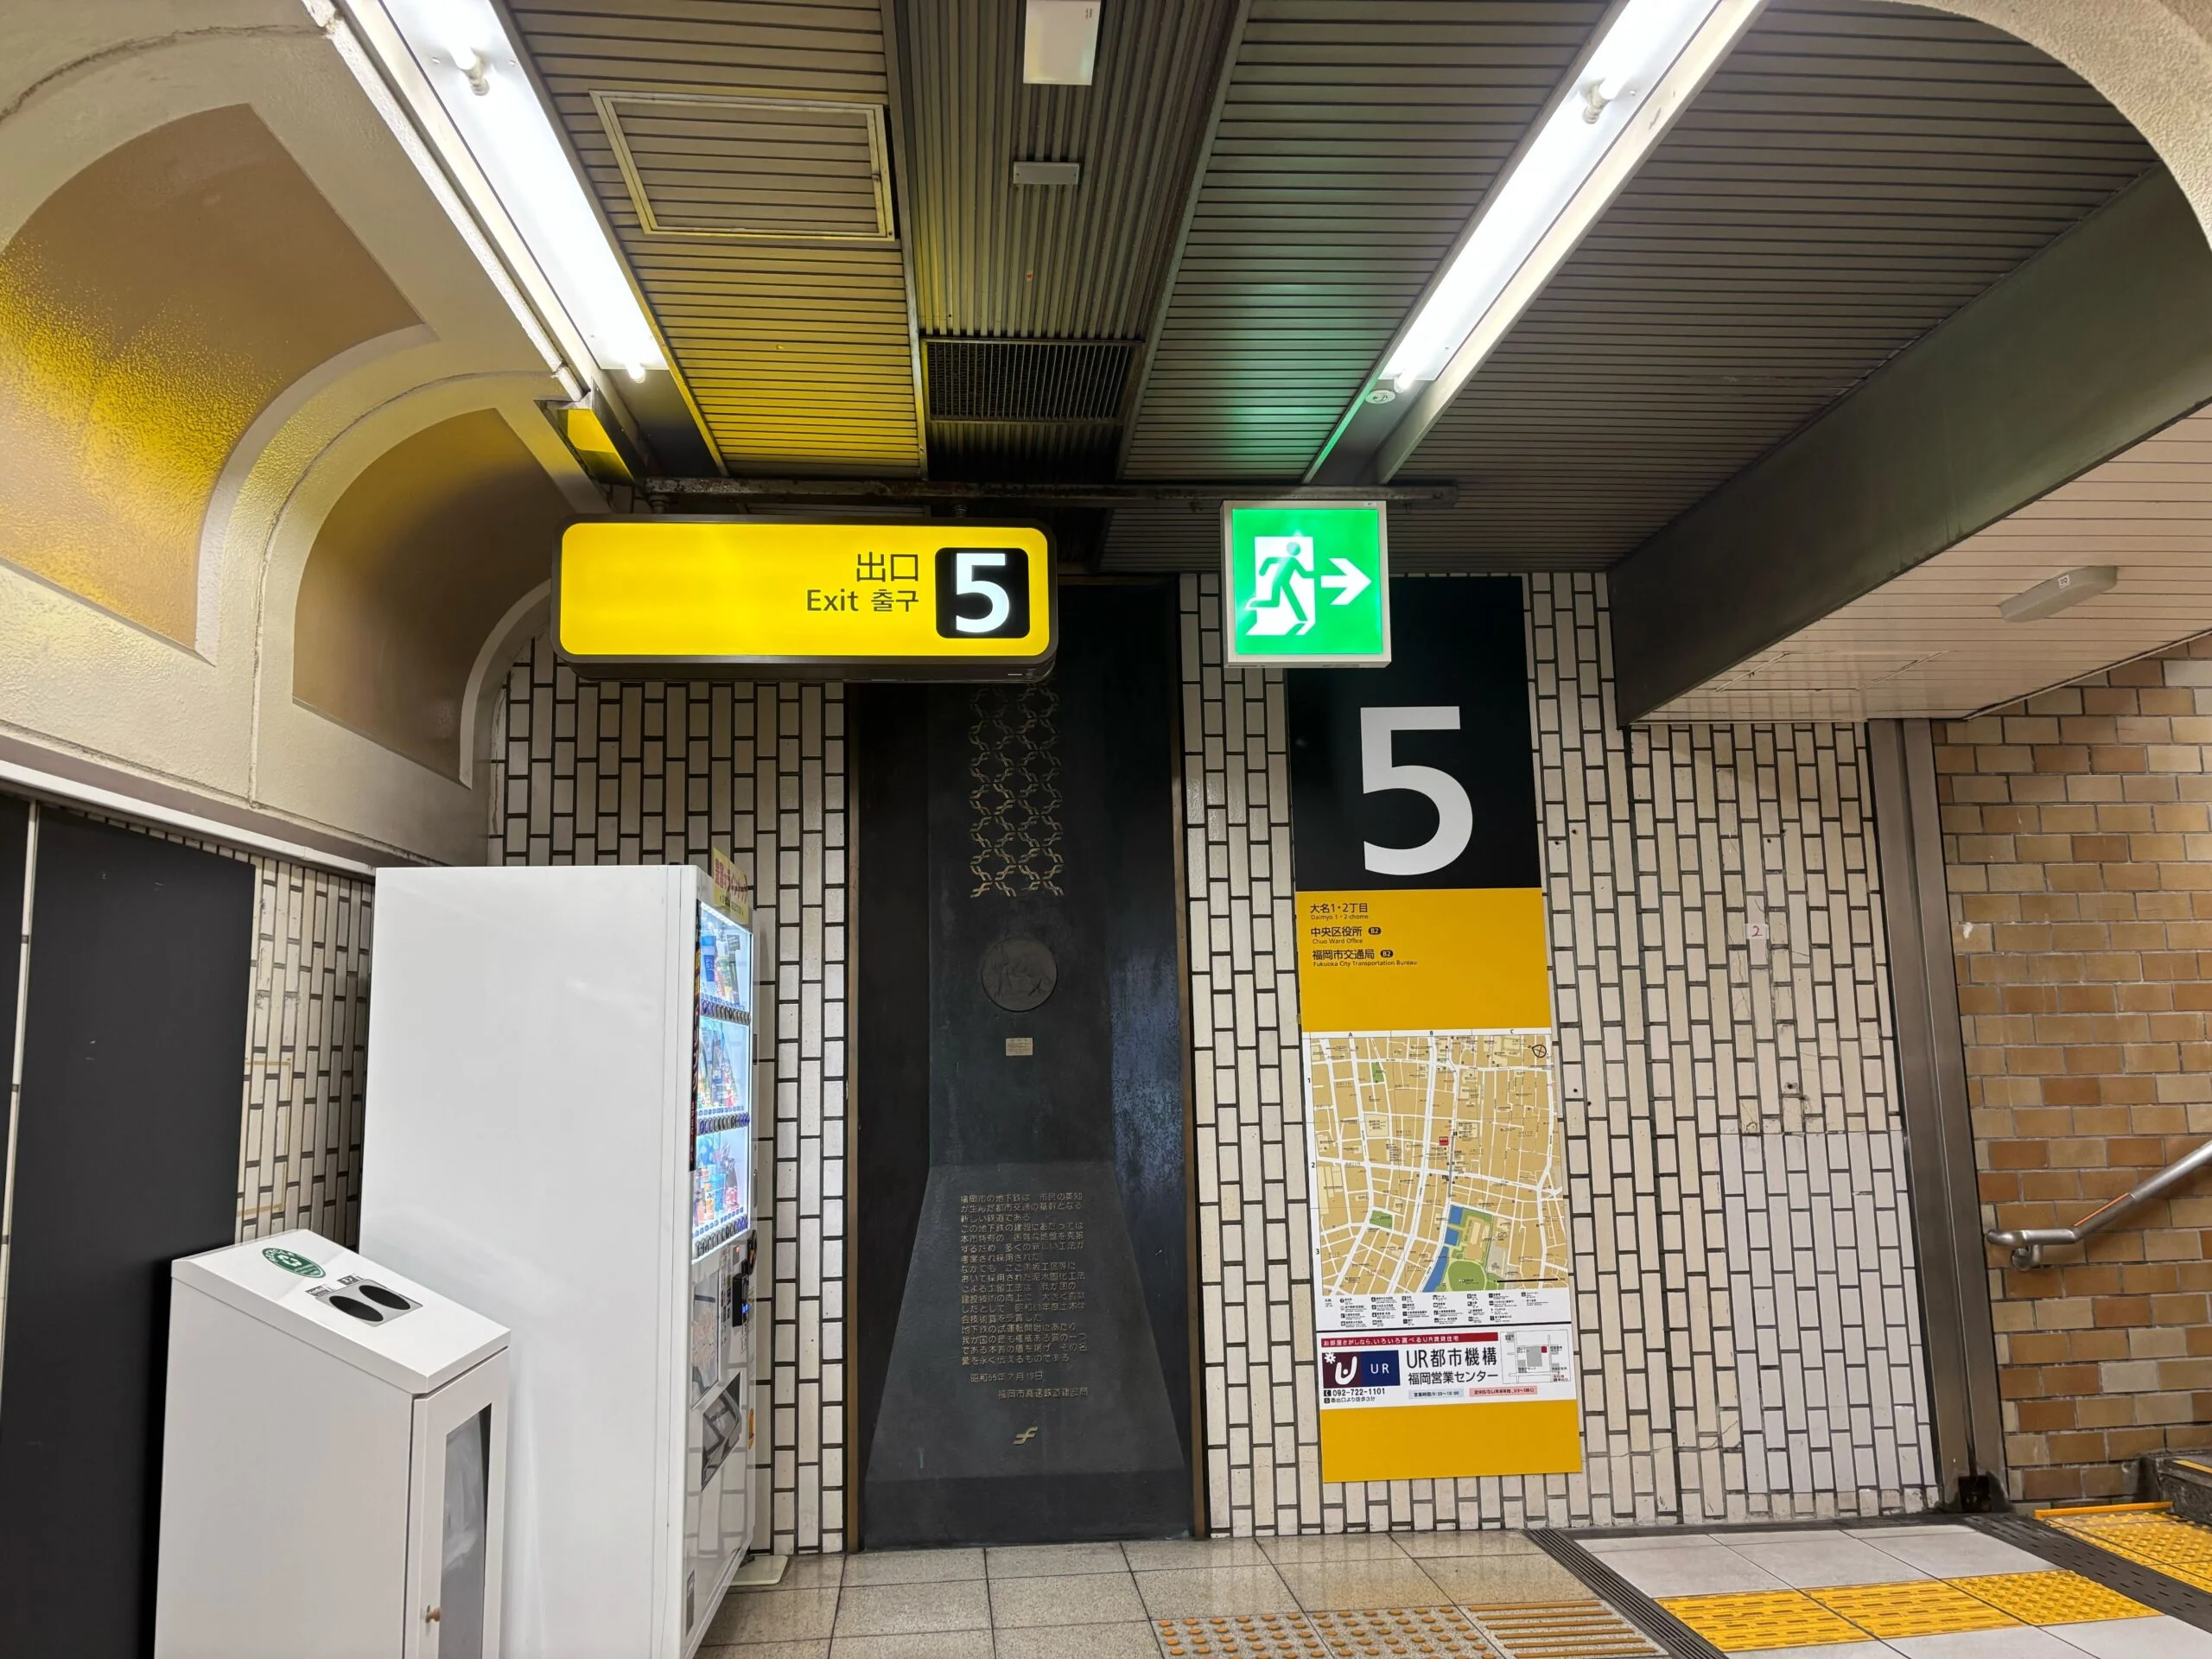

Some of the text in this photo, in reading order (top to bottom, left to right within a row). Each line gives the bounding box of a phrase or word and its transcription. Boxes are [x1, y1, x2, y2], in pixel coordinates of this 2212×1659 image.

[856, 551, 919, 583] 出口
[955, 553, 1010, 632] 5
[807, 589, 919, 613] Exit 출구
[1360, 706, 1473, 875] 5
[1311, 926, 1363, 937] 中央区役所
[1751, 925, 1763, 938] 2
[1313, 949, 1375, 960] 福岡市交通局
[1406, 1346, 1497, 1370] UR都市機構
[1370, 1363, 1390, 1375] UR
[1408, 1371, 1498, 1386] 福岡営業センター
[1332, 1388, 1385, 1396] 092-722-1101
